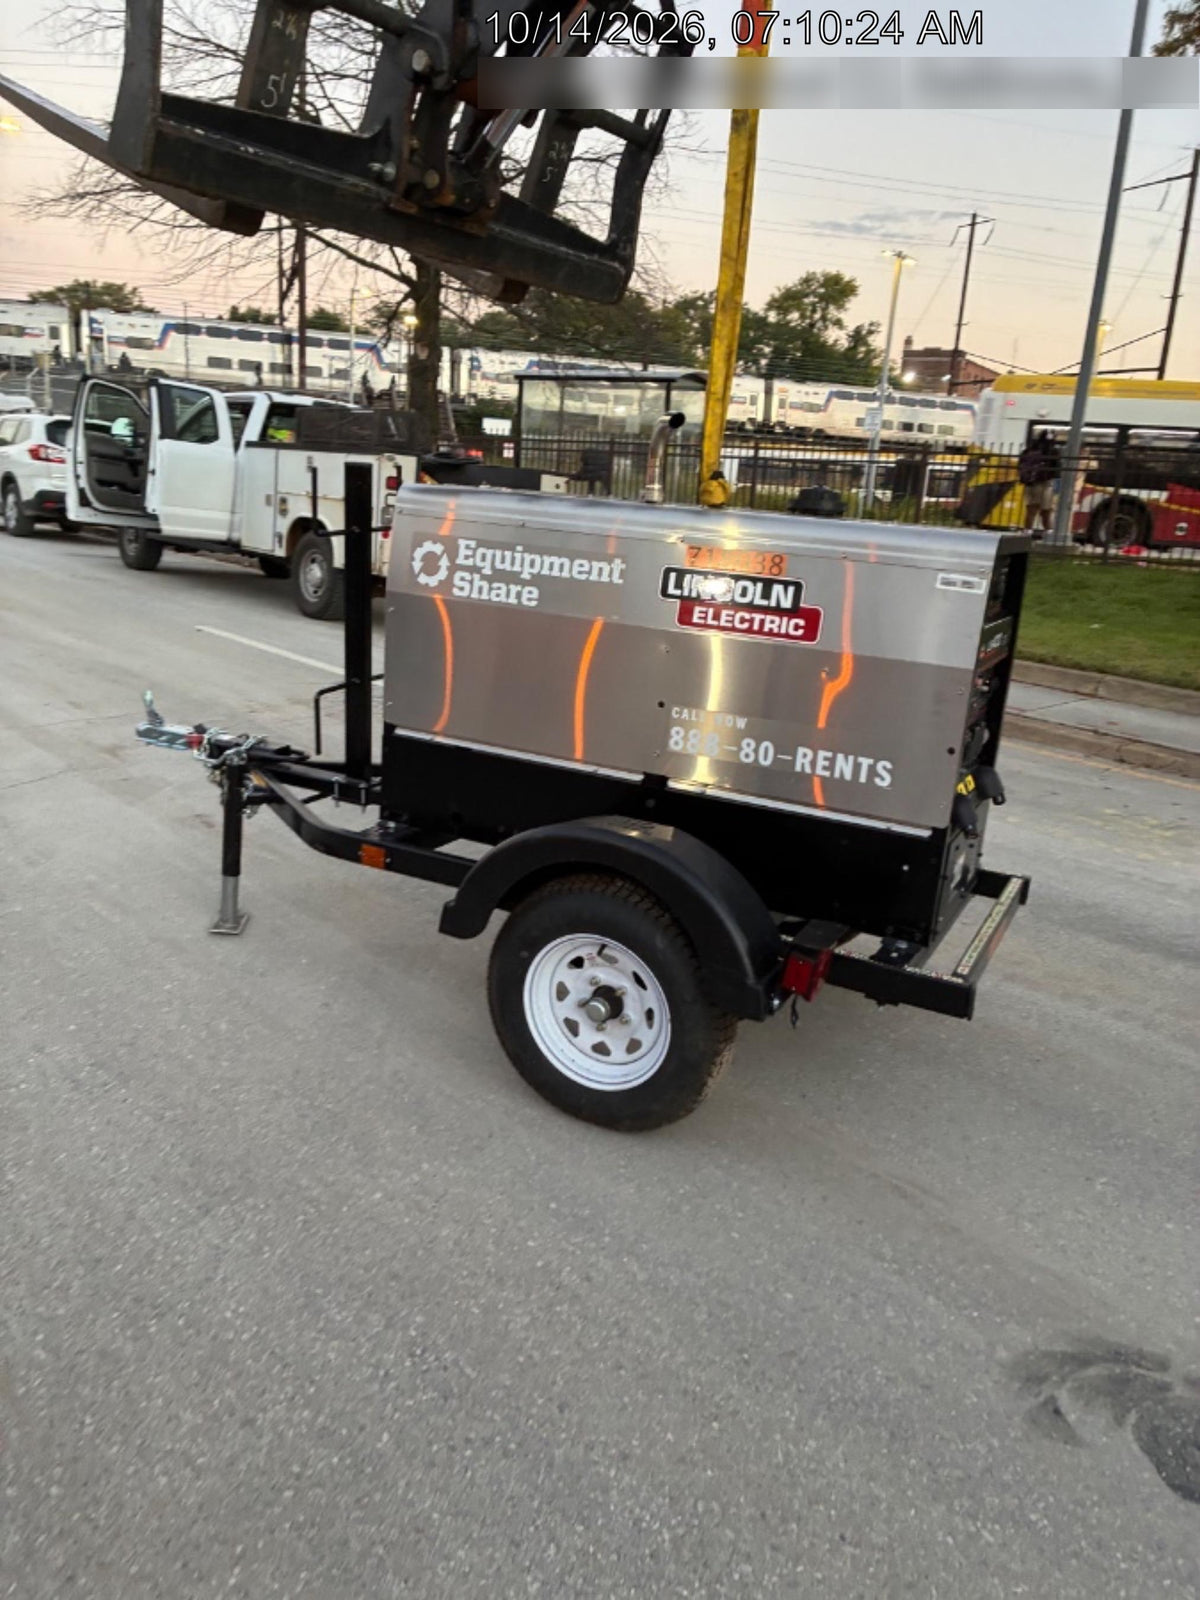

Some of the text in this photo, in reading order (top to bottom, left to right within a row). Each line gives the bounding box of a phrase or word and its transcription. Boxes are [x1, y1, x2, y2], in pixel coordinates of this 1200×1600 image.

[455, 539, 626, 584] Equipment
[452, 571, 540, 607] Share
[692, 606, 806, 636] ELECTRIC
[668, 726, 894, 788] 888-80-RENTS
